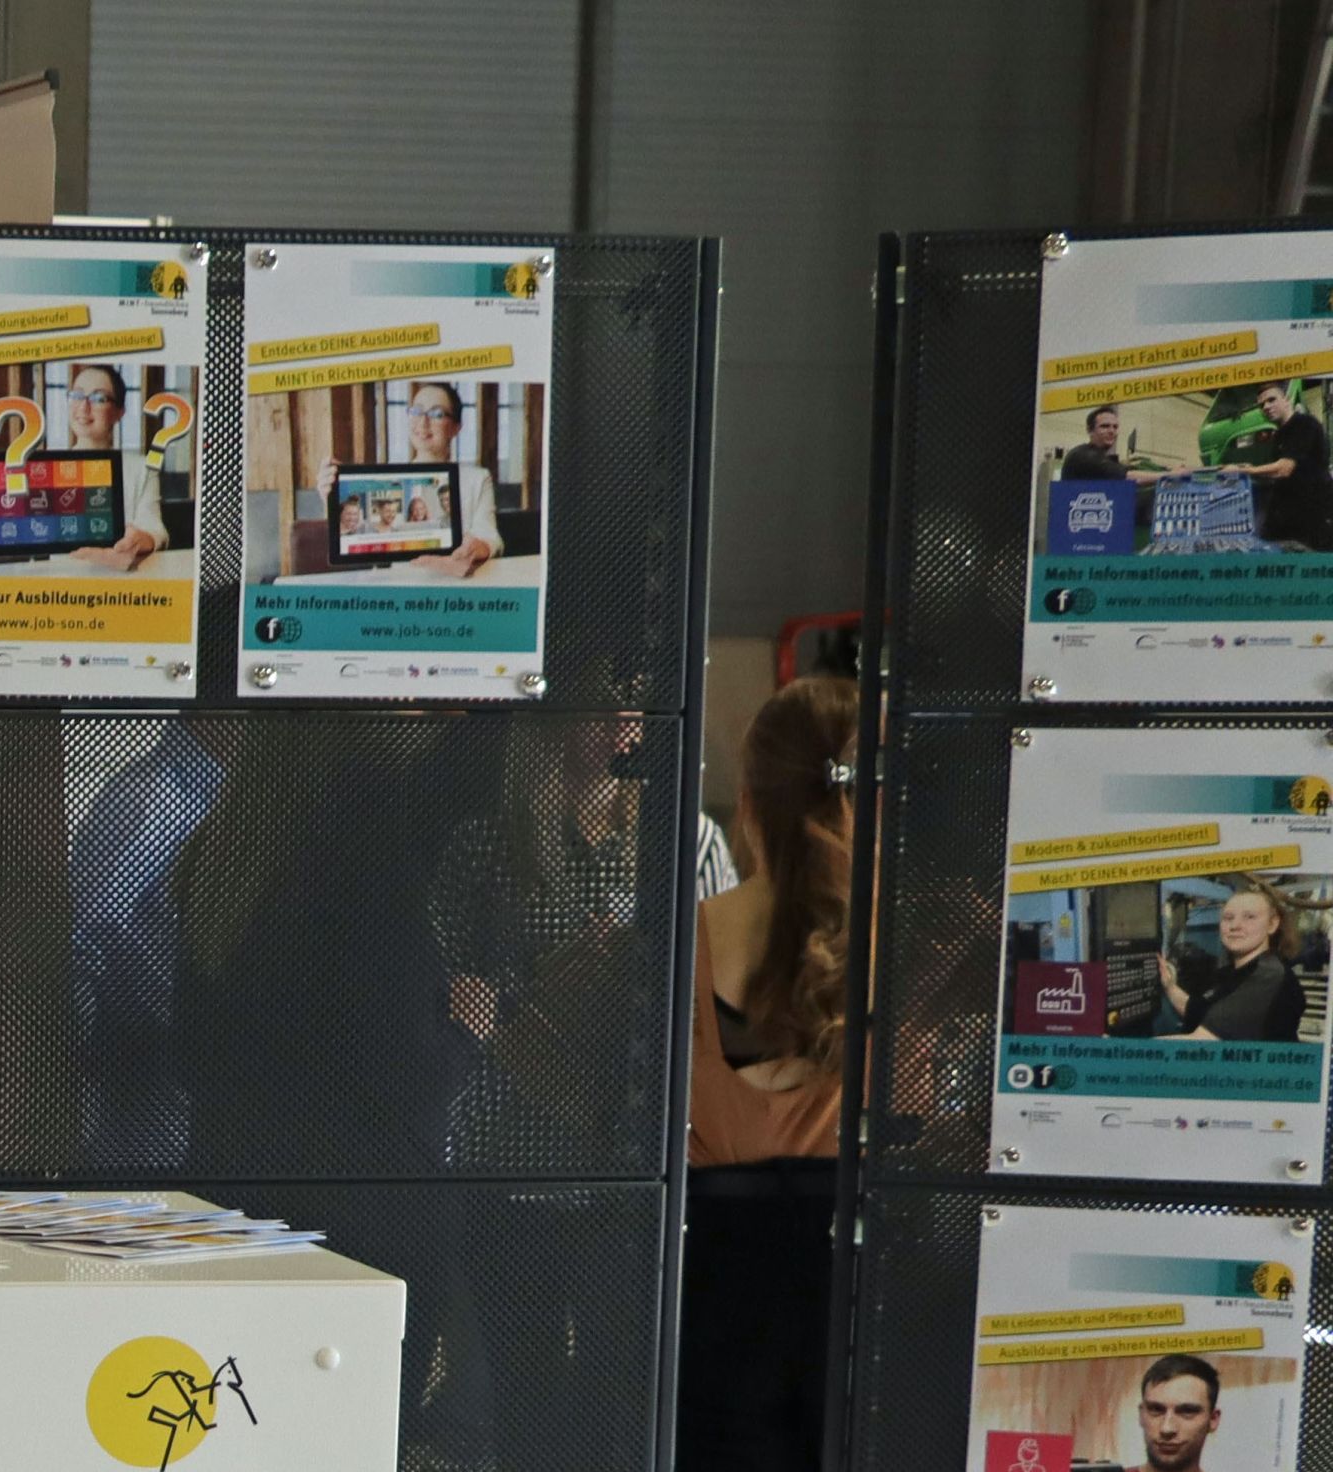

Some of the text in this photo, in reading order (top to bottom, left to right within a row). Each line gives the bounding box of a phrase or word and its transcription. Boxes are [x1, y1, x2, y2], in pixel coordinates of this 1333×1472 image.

[43, 342, 53, 353] in
[55, 338, 93, 352] Sachen
[95, 333, 156, 351] Ausbildung!
[261, 329, 433, 359] Entdecke DEINE Ausbildung!
[1056, 338, 1238, 376] Nimm jetzt Fahrt auf und
[275, 353, 493, 387] MINT in Richtung Zukunft starten!
[1124, 379, 1166, 395] DEINE
[1171, 370, 1228, 389] Karriere
[1233, 367, 1255, 381] ins
[1260, 359, 1308, 376] rollen!
[1044, 564, 1333, 582] Mehr Informationen, mehr MINT unte
[15, 590, 173, 608] Ausbildungsinitiative:
[255, 596, 291, 609] Mehr
[295, 596, 399, 612] Informationen,
[404, 599, 439, 612] mehr
[478, 600, 520, 613] unter:
[360, 624, 474, 639] www.job-son.de
[1025, 828, 1209, 857] Modern & zukunftsorientiert!
[1039, 852, 1273, 886] Mach' DEINEN ersten Karrieresprung!
[1008, 1041, 1316, 1066] Mehr Informationen, mehr MINT unter:
[1086, 1072, 1314, 1091] www.mintfreundliche-stadt.de
[991, 1309, 1177, 1329] Mit Leidenschaft und Pflege-Kraft!
[999, 1333, 1246, 1359] Ausbildung zum wahren Helden starten!
